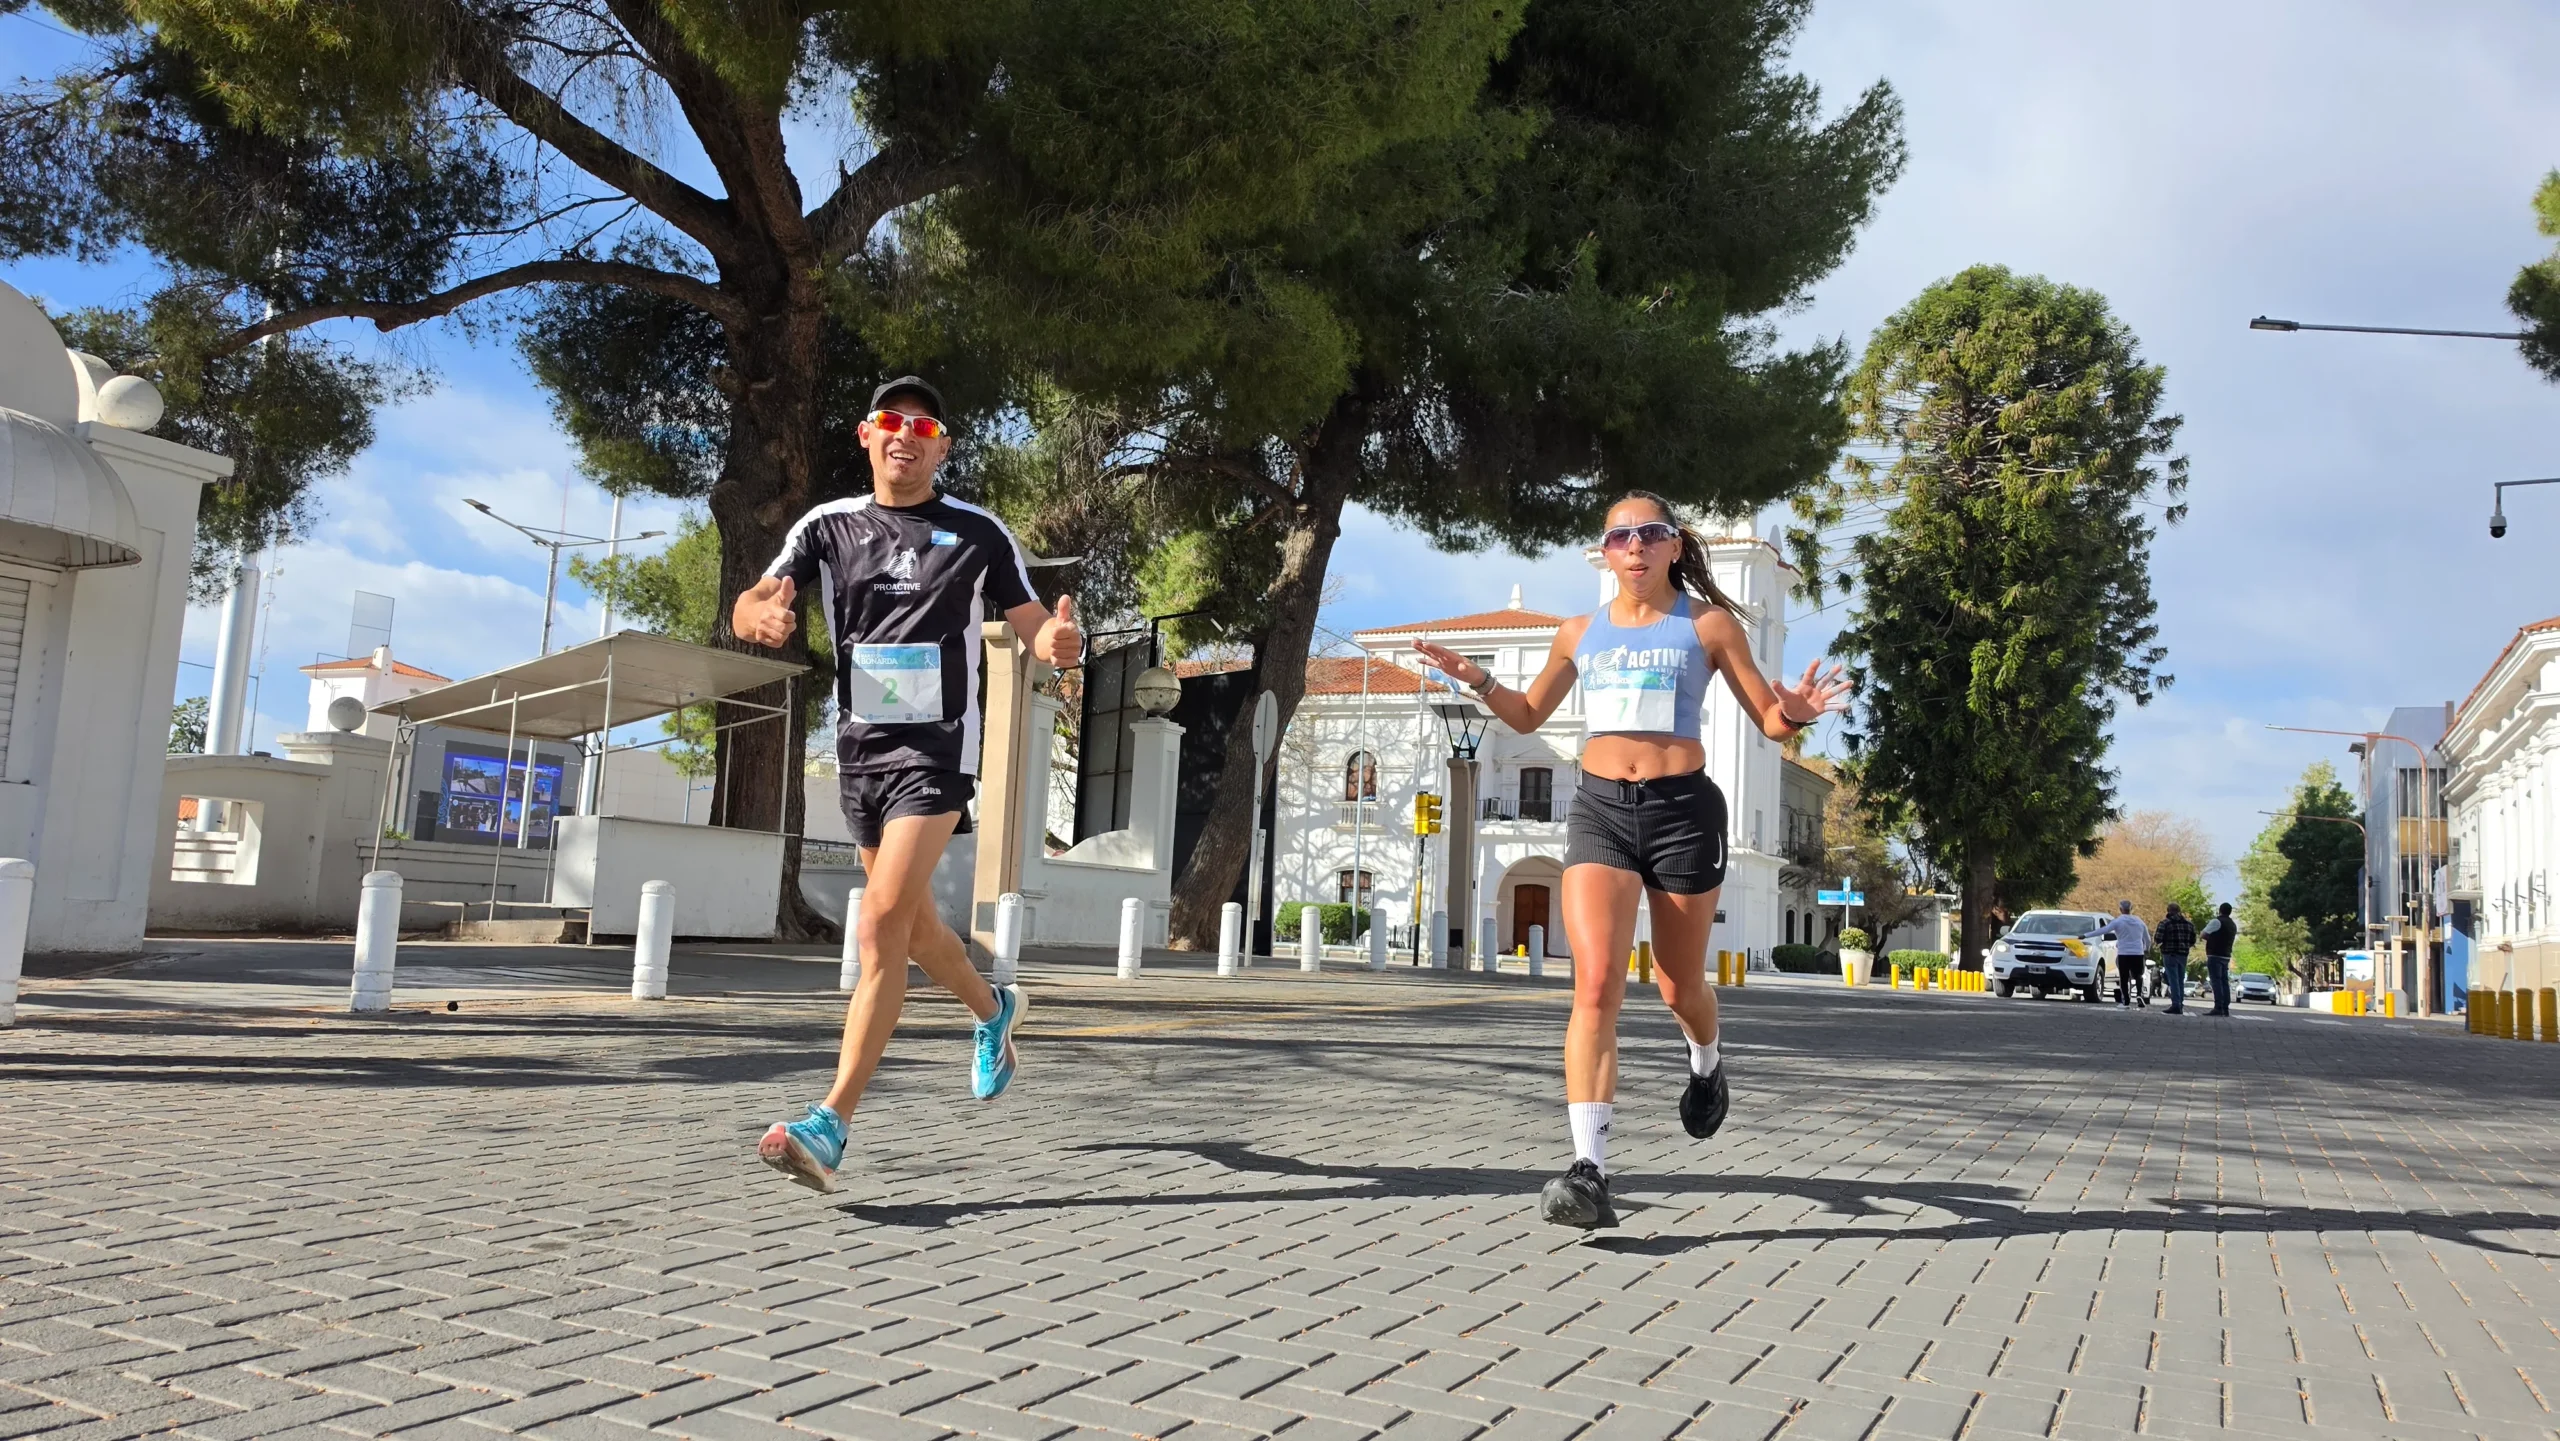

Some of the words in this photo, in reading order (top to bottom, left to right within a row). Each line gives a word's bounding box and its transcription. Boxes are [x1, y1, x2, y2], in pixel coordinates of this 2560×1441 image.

[873, 582, 921, 592] PROACTIVE
[860, 657, 899, 665] BONARDA
[1626, 648, 1689, 670] ACTIVE
[881, 677, 899, 704] 2
[1616, 696, 1629, 723] 7
[922, 786, 942, 795] DRB
